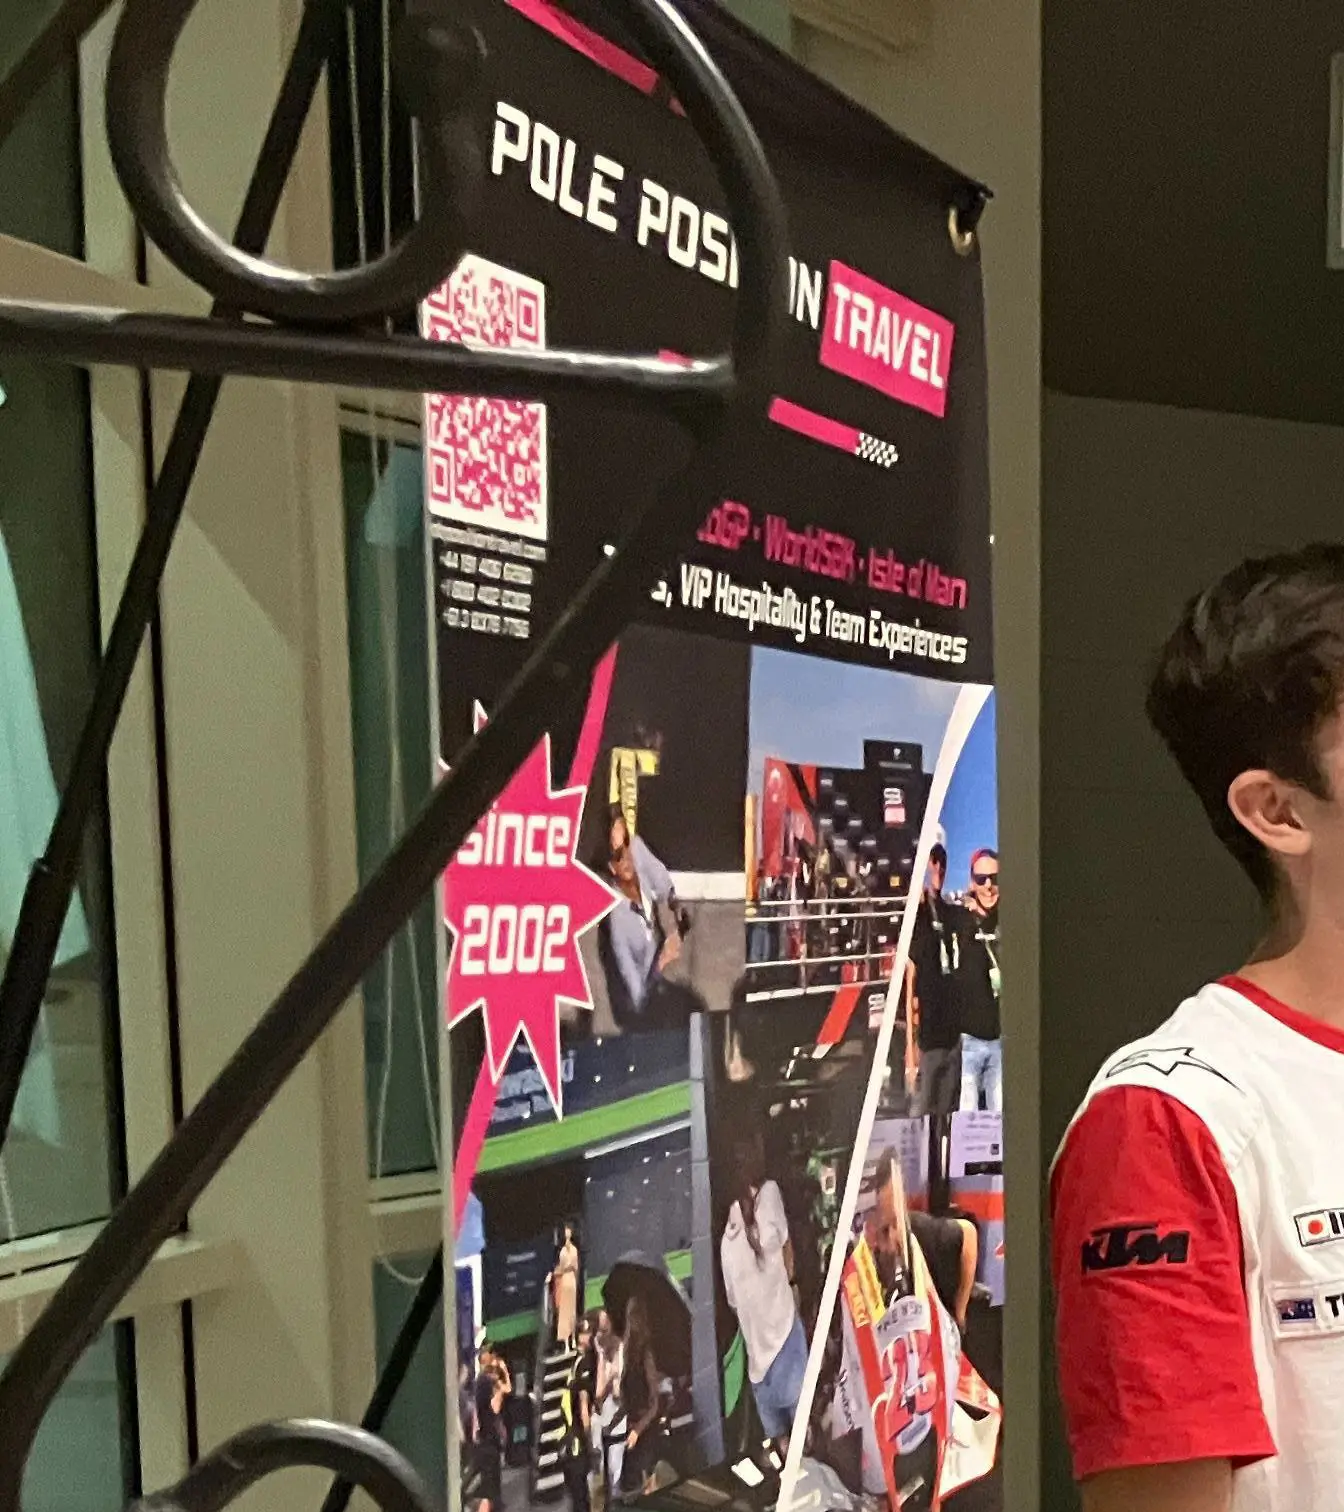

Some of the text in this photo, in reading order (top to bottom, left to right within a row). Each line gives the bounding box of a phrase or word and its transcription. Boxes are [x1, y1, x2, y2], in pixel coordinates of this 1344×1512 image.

[491, 101, 625, 232] POLE
[833, 282, 945, 389] TRAVEL
[681, 562, 713, 609] VIP
[715, 571, 808, 643] Hospitality
[809, 595, 822, 635] &
[825, 598, 866, 645] Team
[868, 609, 969, 664] Experiences
[460, 904, 571, 976] 2002
[1083, 1224, 1189, 1271] KTM
